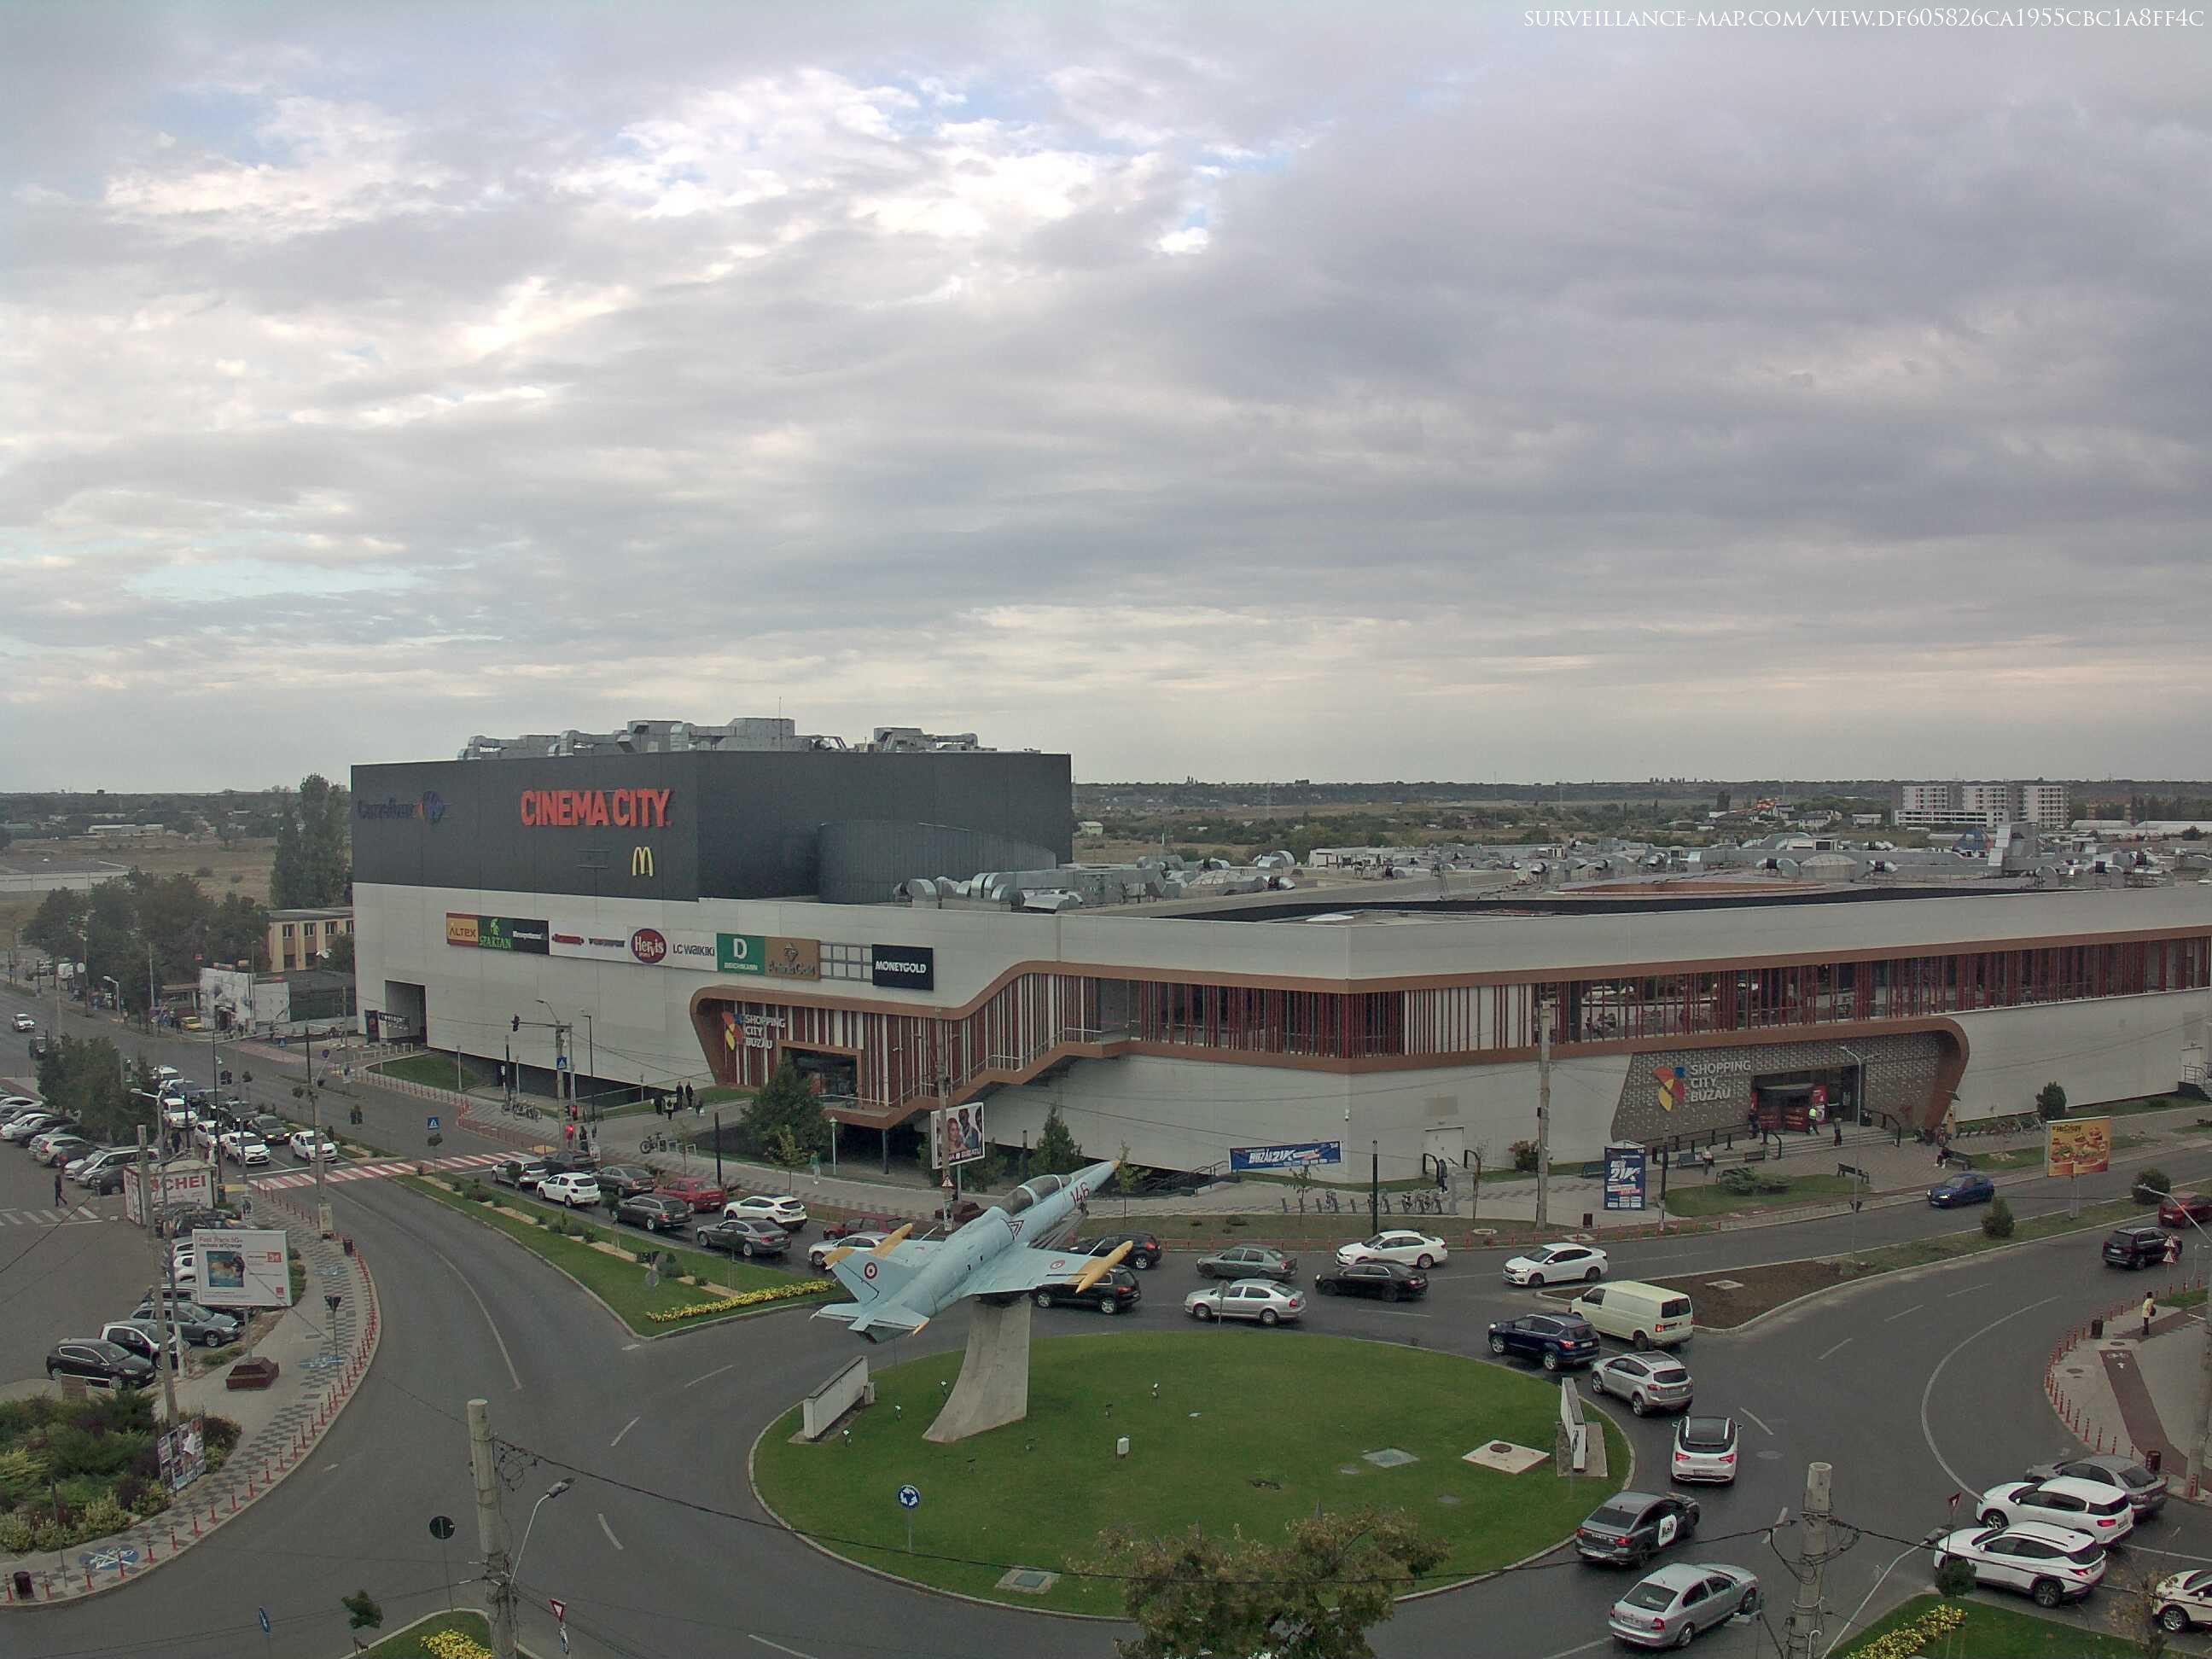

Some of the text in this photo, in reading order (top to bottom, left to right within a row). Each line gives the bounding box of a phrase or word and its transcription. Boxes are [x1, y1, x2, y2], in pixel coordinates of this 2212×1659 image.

[521, 788, 670, 826] CINEMA CITY
[479, 935, 512, 949] SPARTAN
[634, 935, 665, 957] Hervis
[672, 943, 684, 954] LC
[733, 938, 748, 960] D
[875, 960, 927, 974] MONEYGOLD
[745, 1014, 786, 1028] SHOPPING
[745, 1026, 764, 1036] CITY
[1690, 1060, 1751, 1075] SHOPPING
[1690, 1077, 1718, 1089] CITY
[165, 1175, 207, 1190] CHEI
[1070, 1182, 1090, 1207] 146
